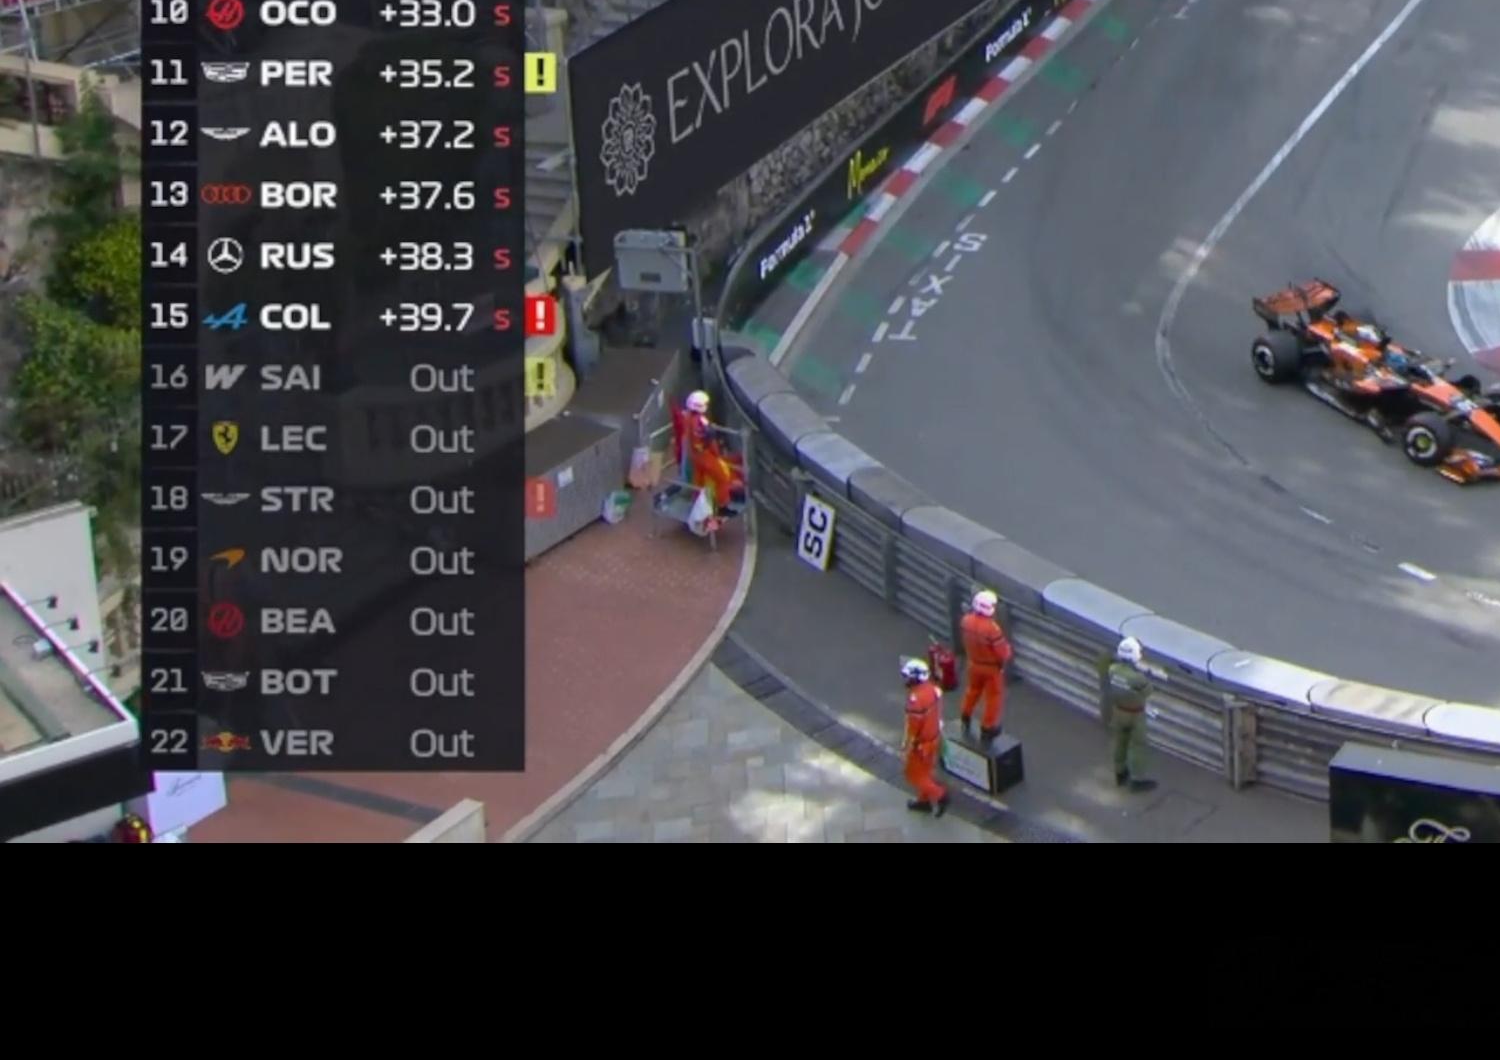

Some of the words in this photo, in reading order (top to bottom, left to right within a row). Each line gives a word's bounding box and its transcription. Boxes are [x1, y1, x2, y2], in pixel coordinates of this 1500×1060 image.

[985, 18, 1024, 64] Formula
[760, 223, 806, 280] Formula
[889, 231, 988, 342] TAXIS
[804, 506, 828, 559] SC
